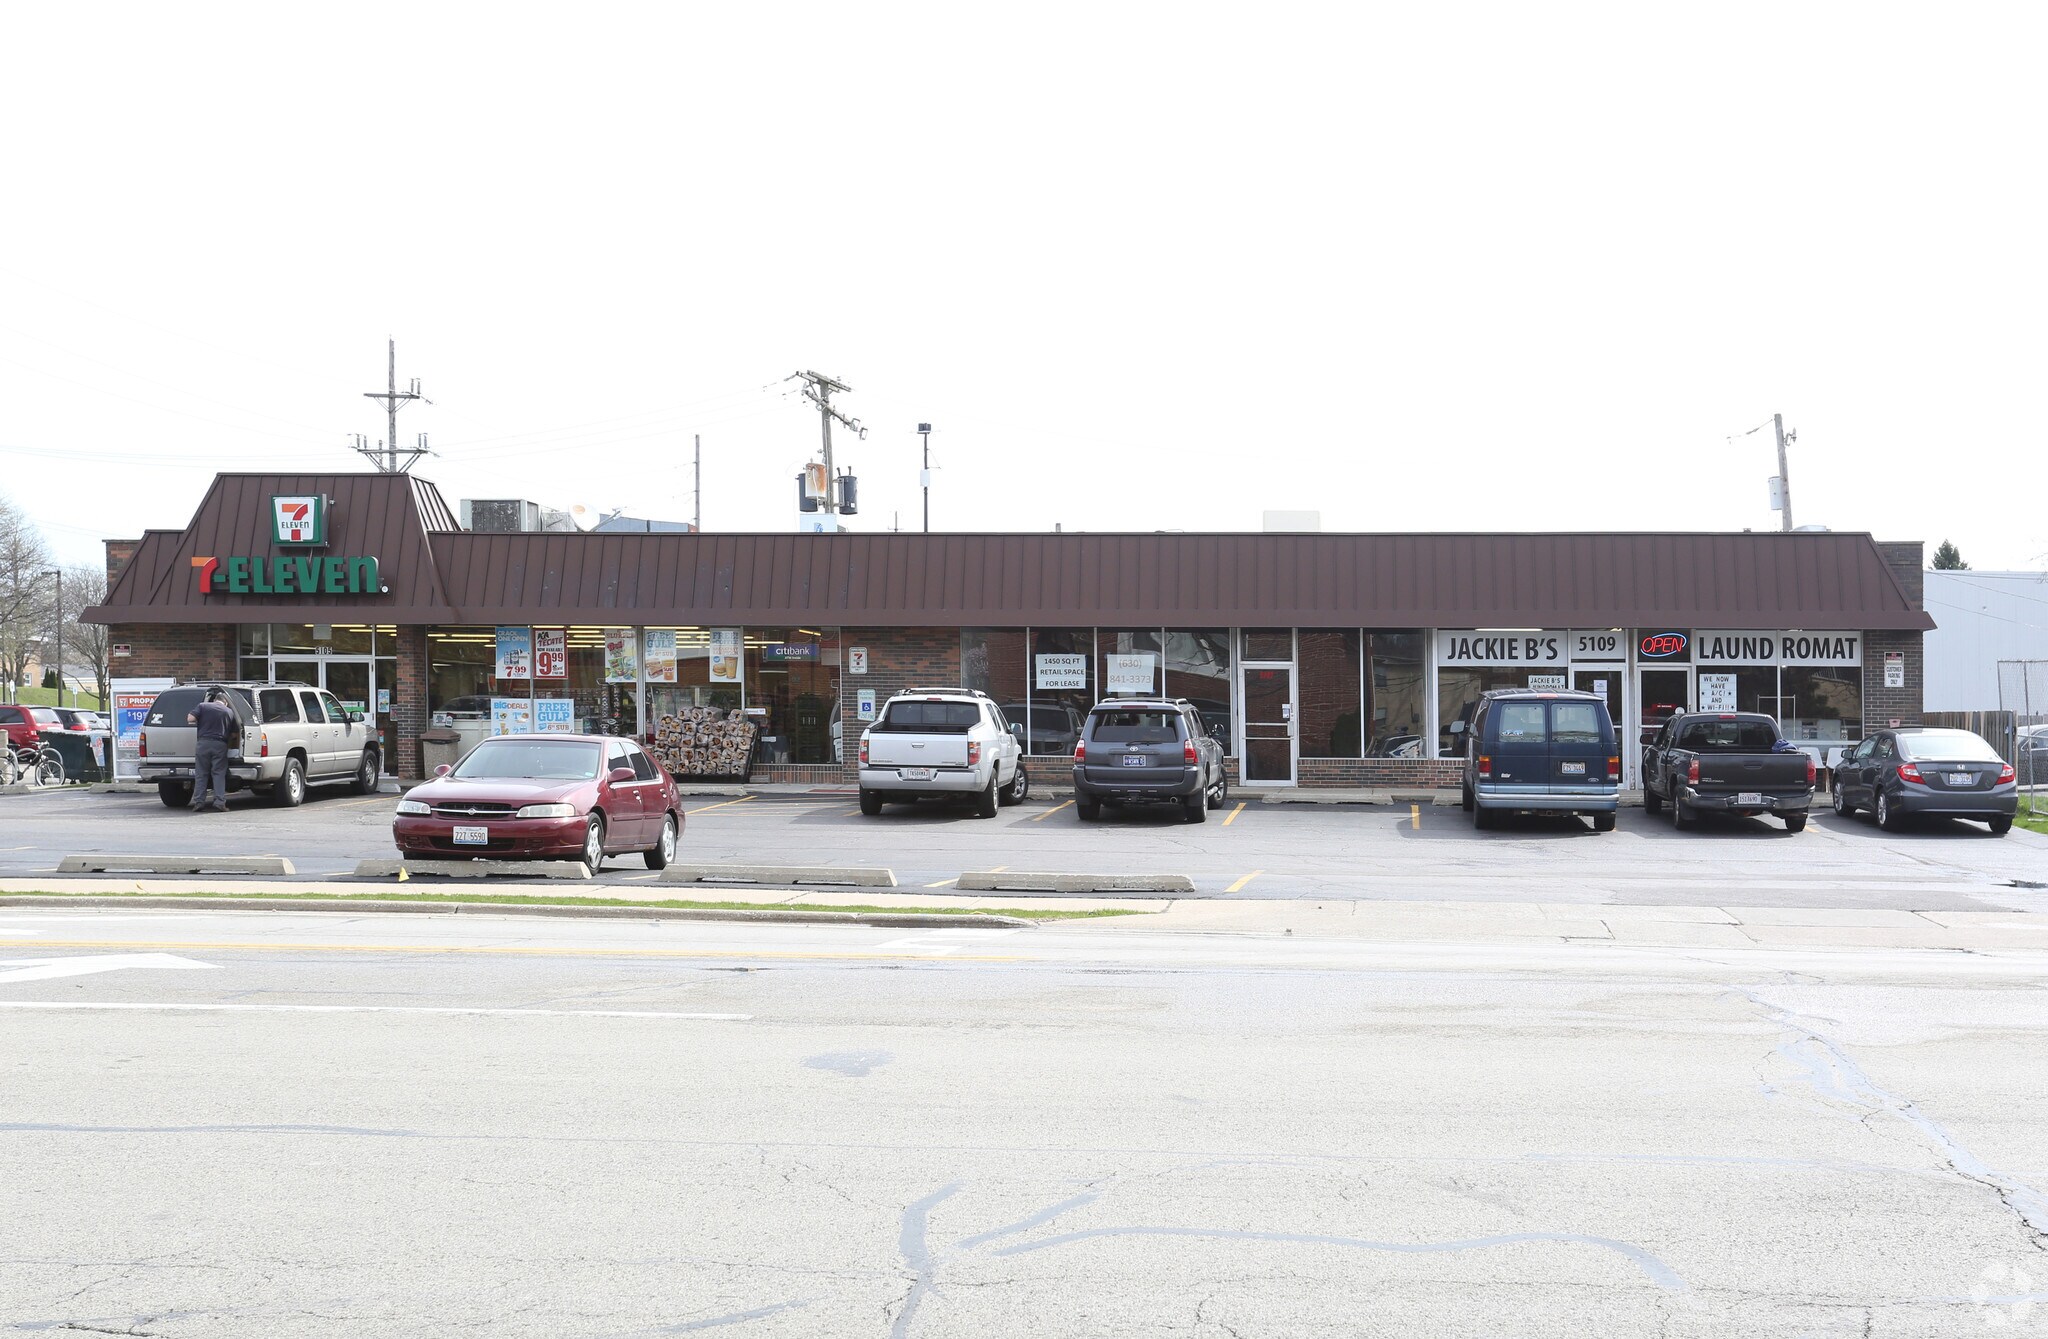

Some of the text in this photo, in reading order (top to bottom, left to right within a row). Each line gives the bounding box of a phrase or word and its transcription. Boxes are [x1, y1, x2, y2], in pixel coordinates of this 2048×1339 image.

[1447, 637, 1558, 661] JACKIE B'S
[1578, 636, 1616, 652] 5109
[1641, 637, 1684, 653] OPEN
[315, 646, 333, 655] 5105
[775, 646, 810, 656] citibank
[1119, 659, 1142, 669] (630)
[1064, 668, 1085, 676] SPACE
[129, 697, 156, 705] PROPA
[538, 702, 570, 712] FREE!
[537, 711, 570, 722] GULP
[470, 832, 486, 841] 5590
